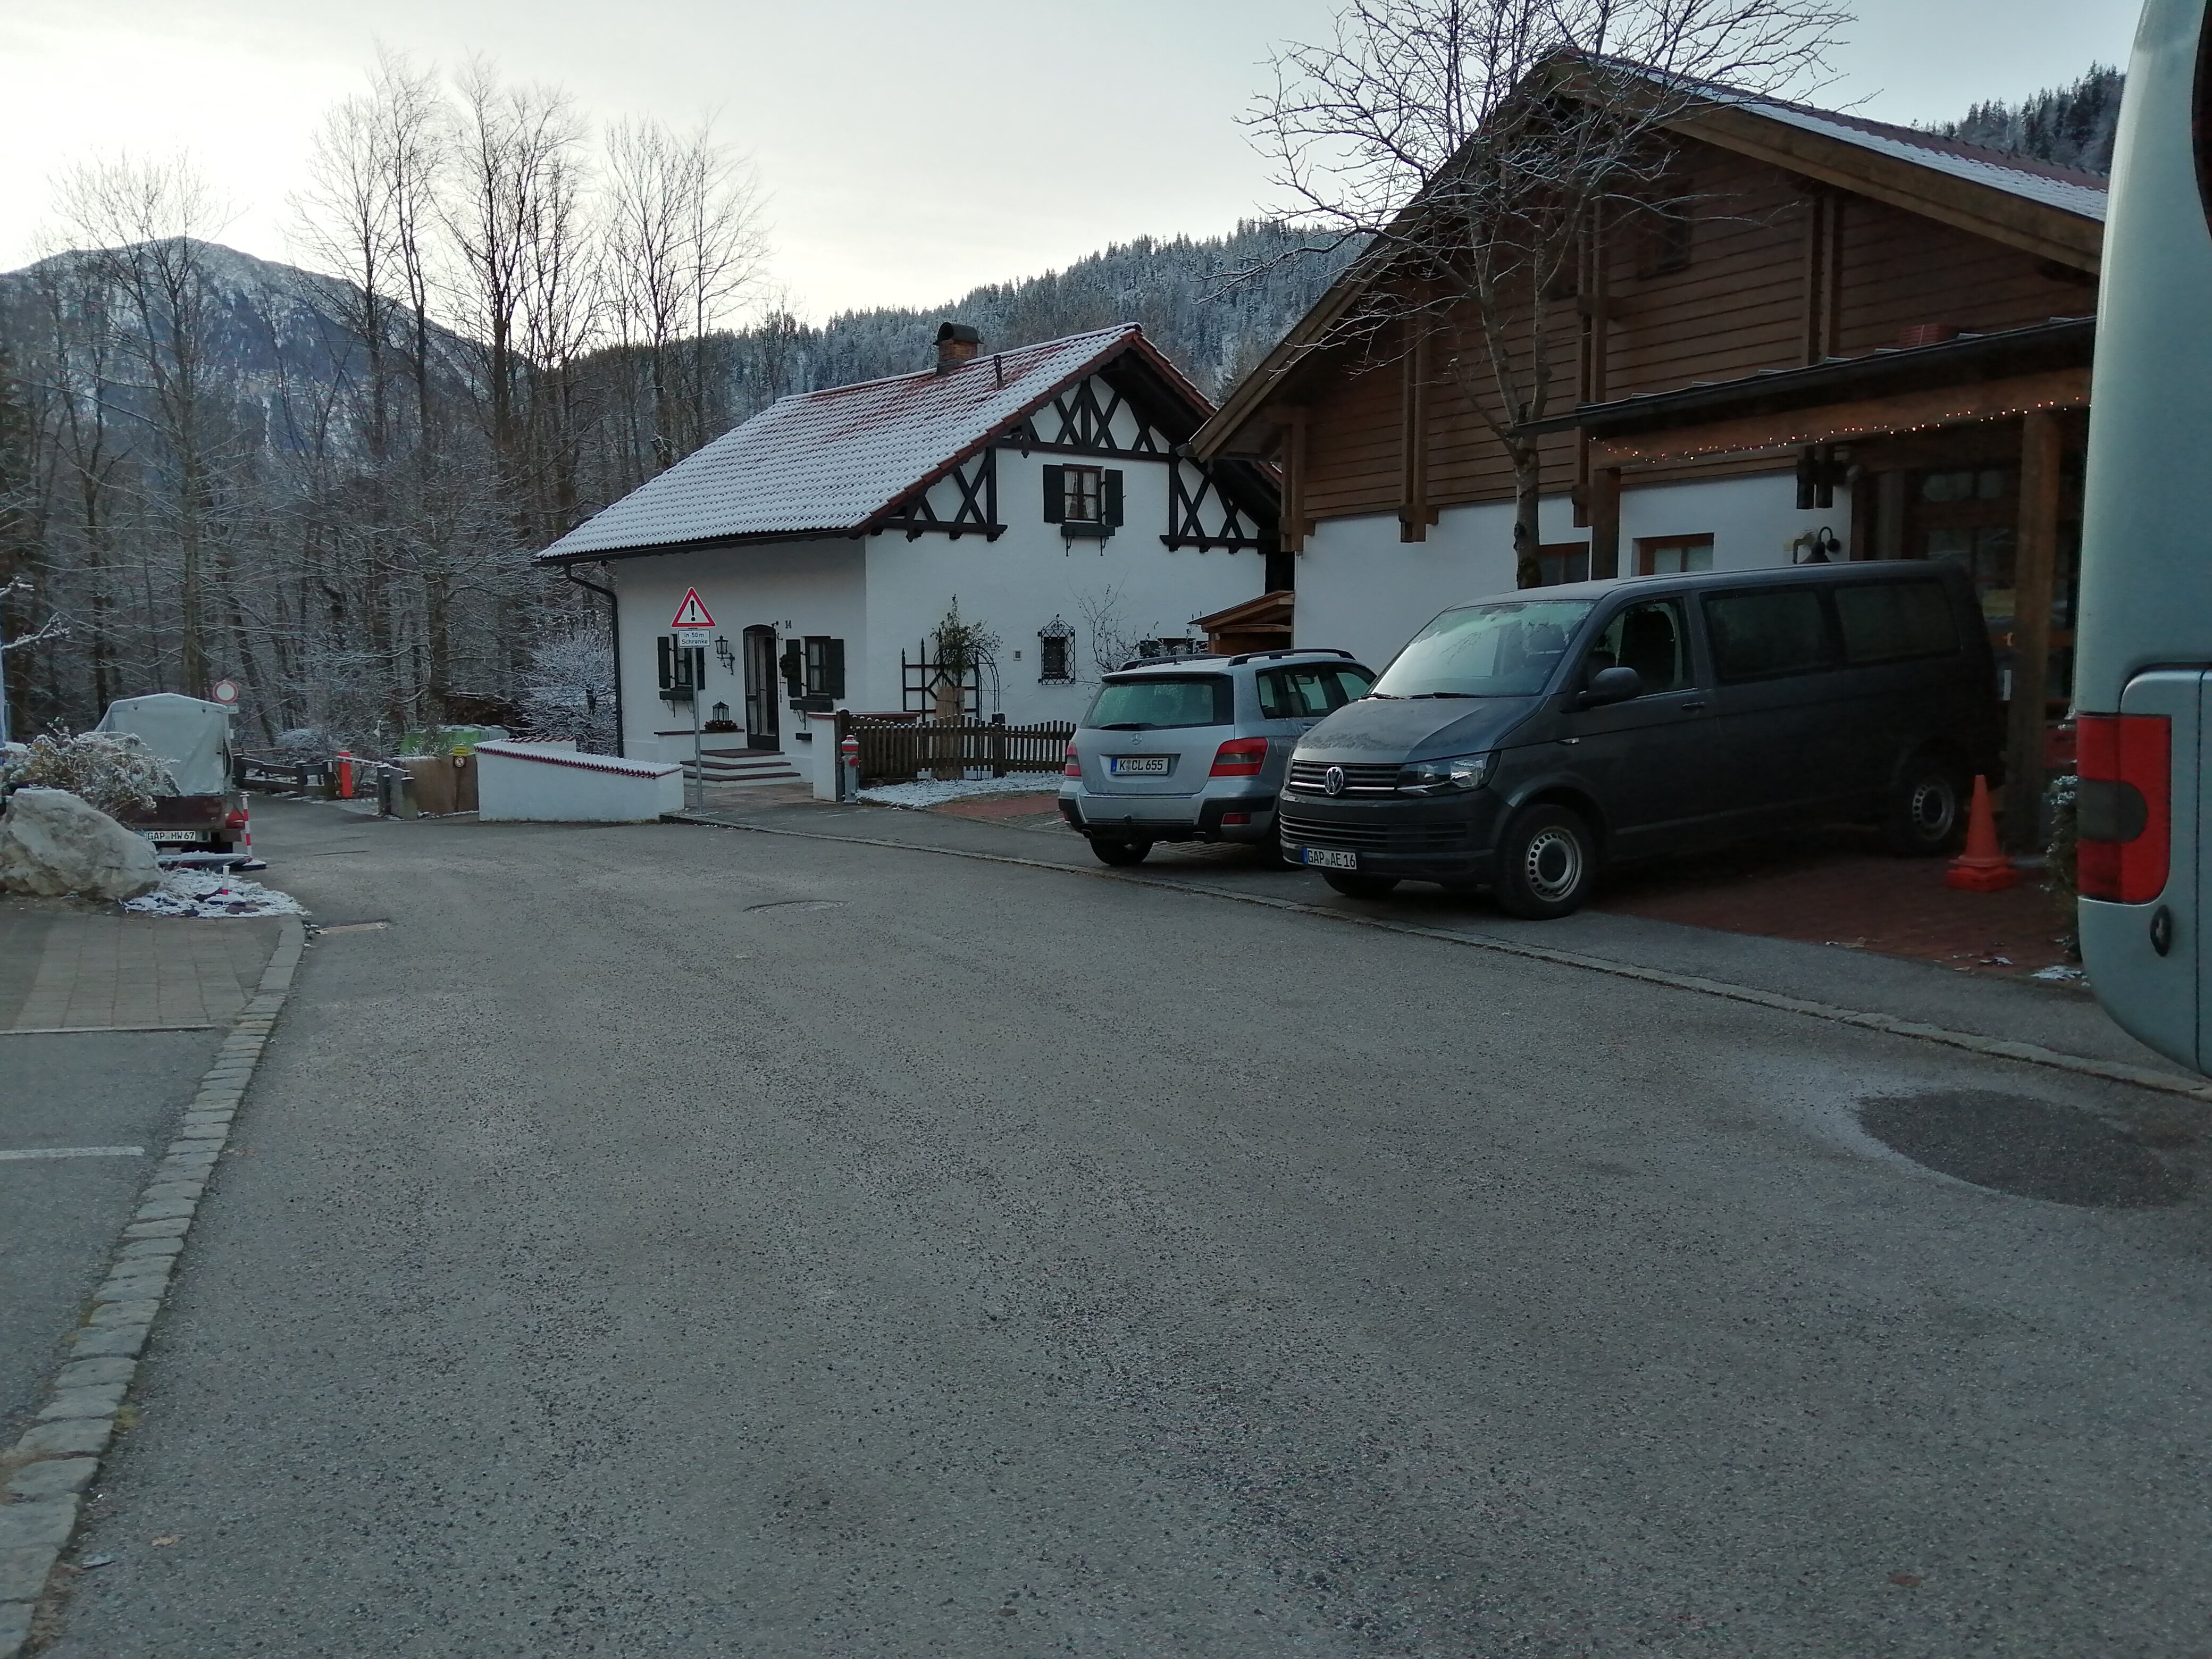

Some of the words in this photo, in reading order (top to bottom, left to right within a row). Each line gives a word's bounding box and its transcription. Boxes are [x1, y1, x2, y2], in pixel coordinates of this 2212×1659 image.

[785, 620, 792, 629] 14
[1119, 760, 1126, 770] K
[1132, 760, 1143, 770] CL
[1145, 760, 1163, 770] 655
[1308, 850, 1324, 864] GAP
[1330, 853, 1342, 866] AE
[1343, 855, 1355, 868] 16
